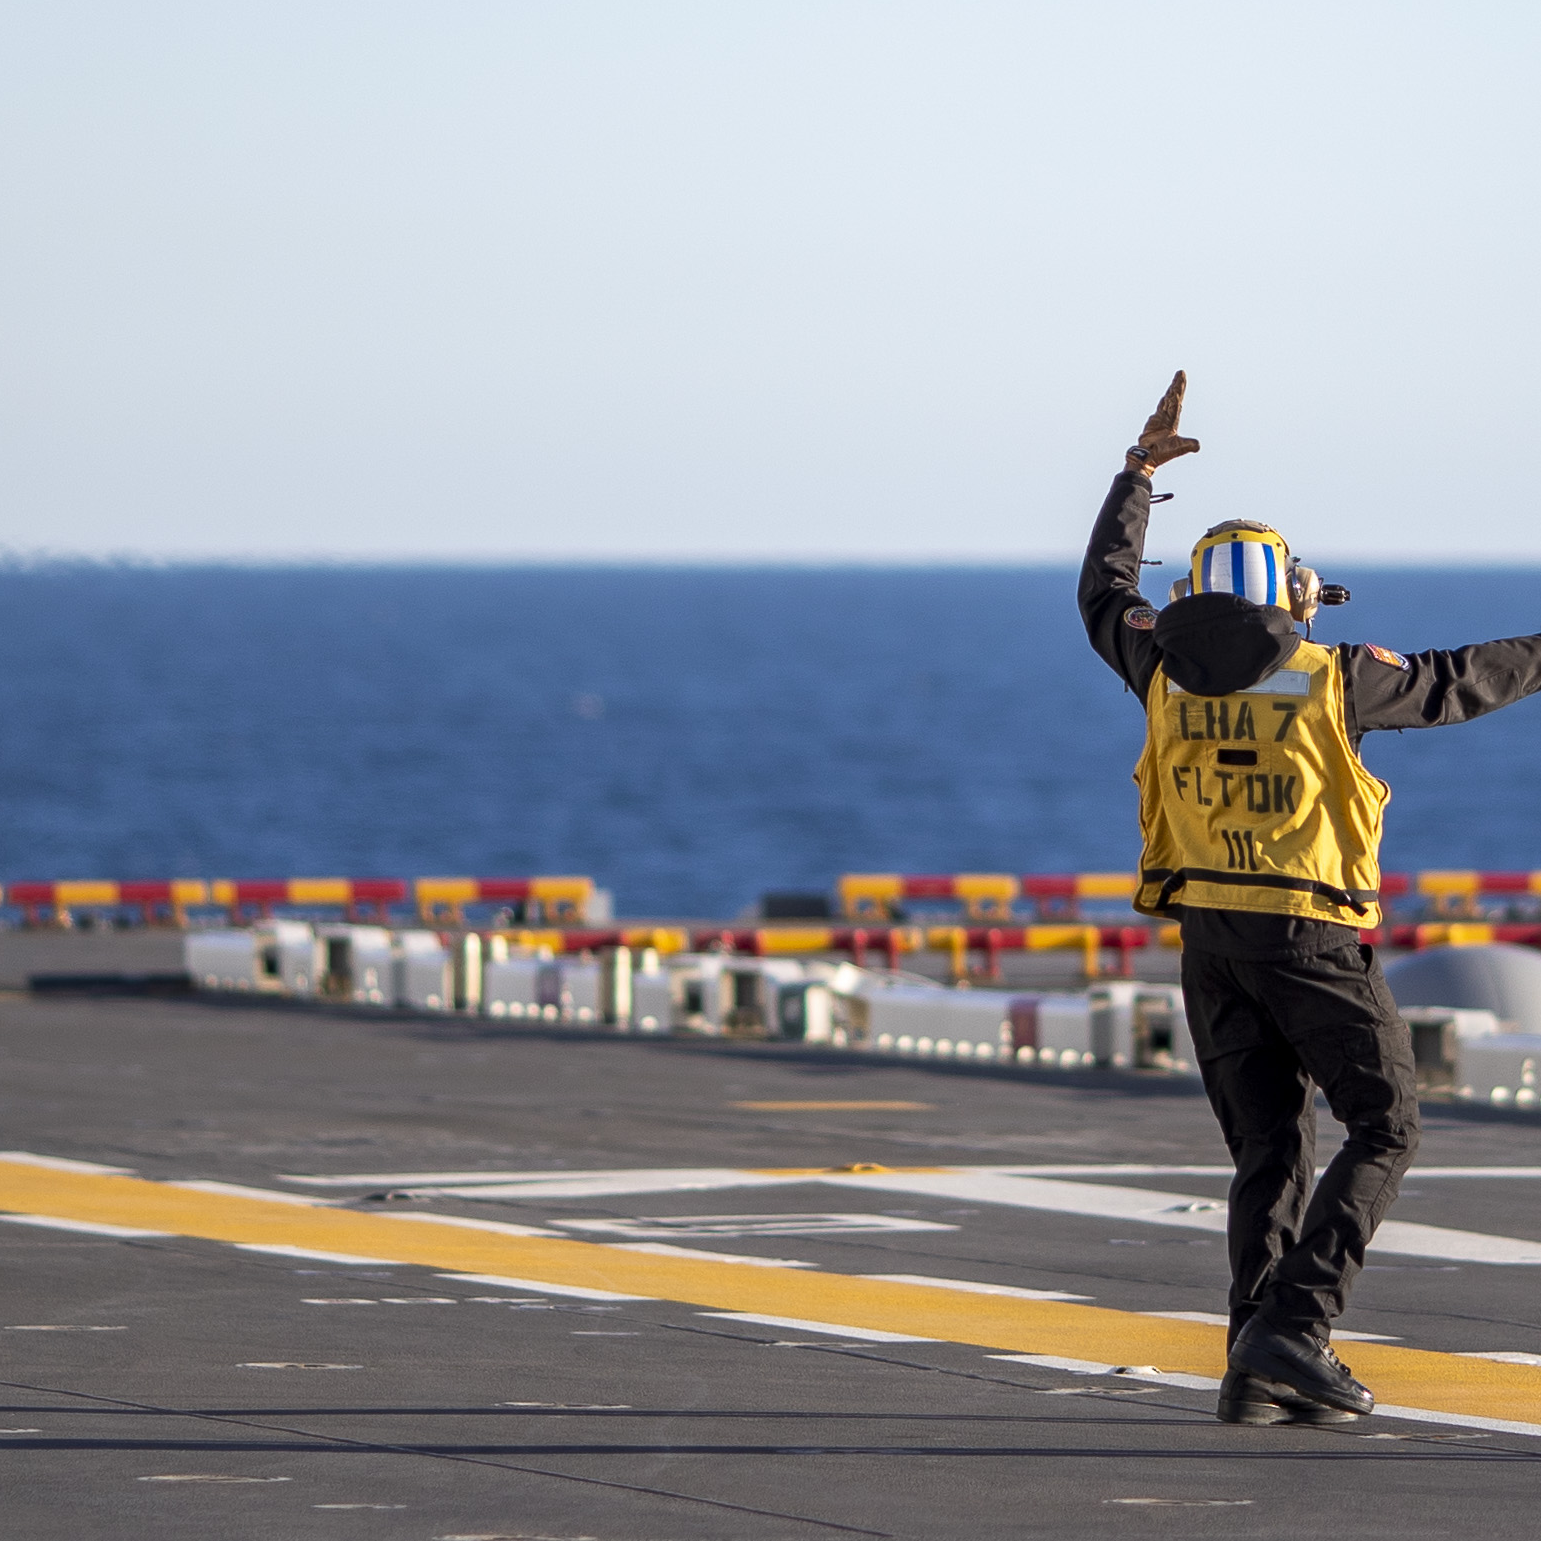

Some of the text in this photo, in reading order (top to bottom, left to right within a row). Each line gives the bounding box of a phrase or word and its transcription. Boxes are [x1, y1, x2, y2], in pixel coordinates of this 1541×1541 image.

[1179, 701, 1297, 742] LHA 7
[1172, 766, 1297, 815] FLT DK
[1221, 829, 1259, 871] 111
